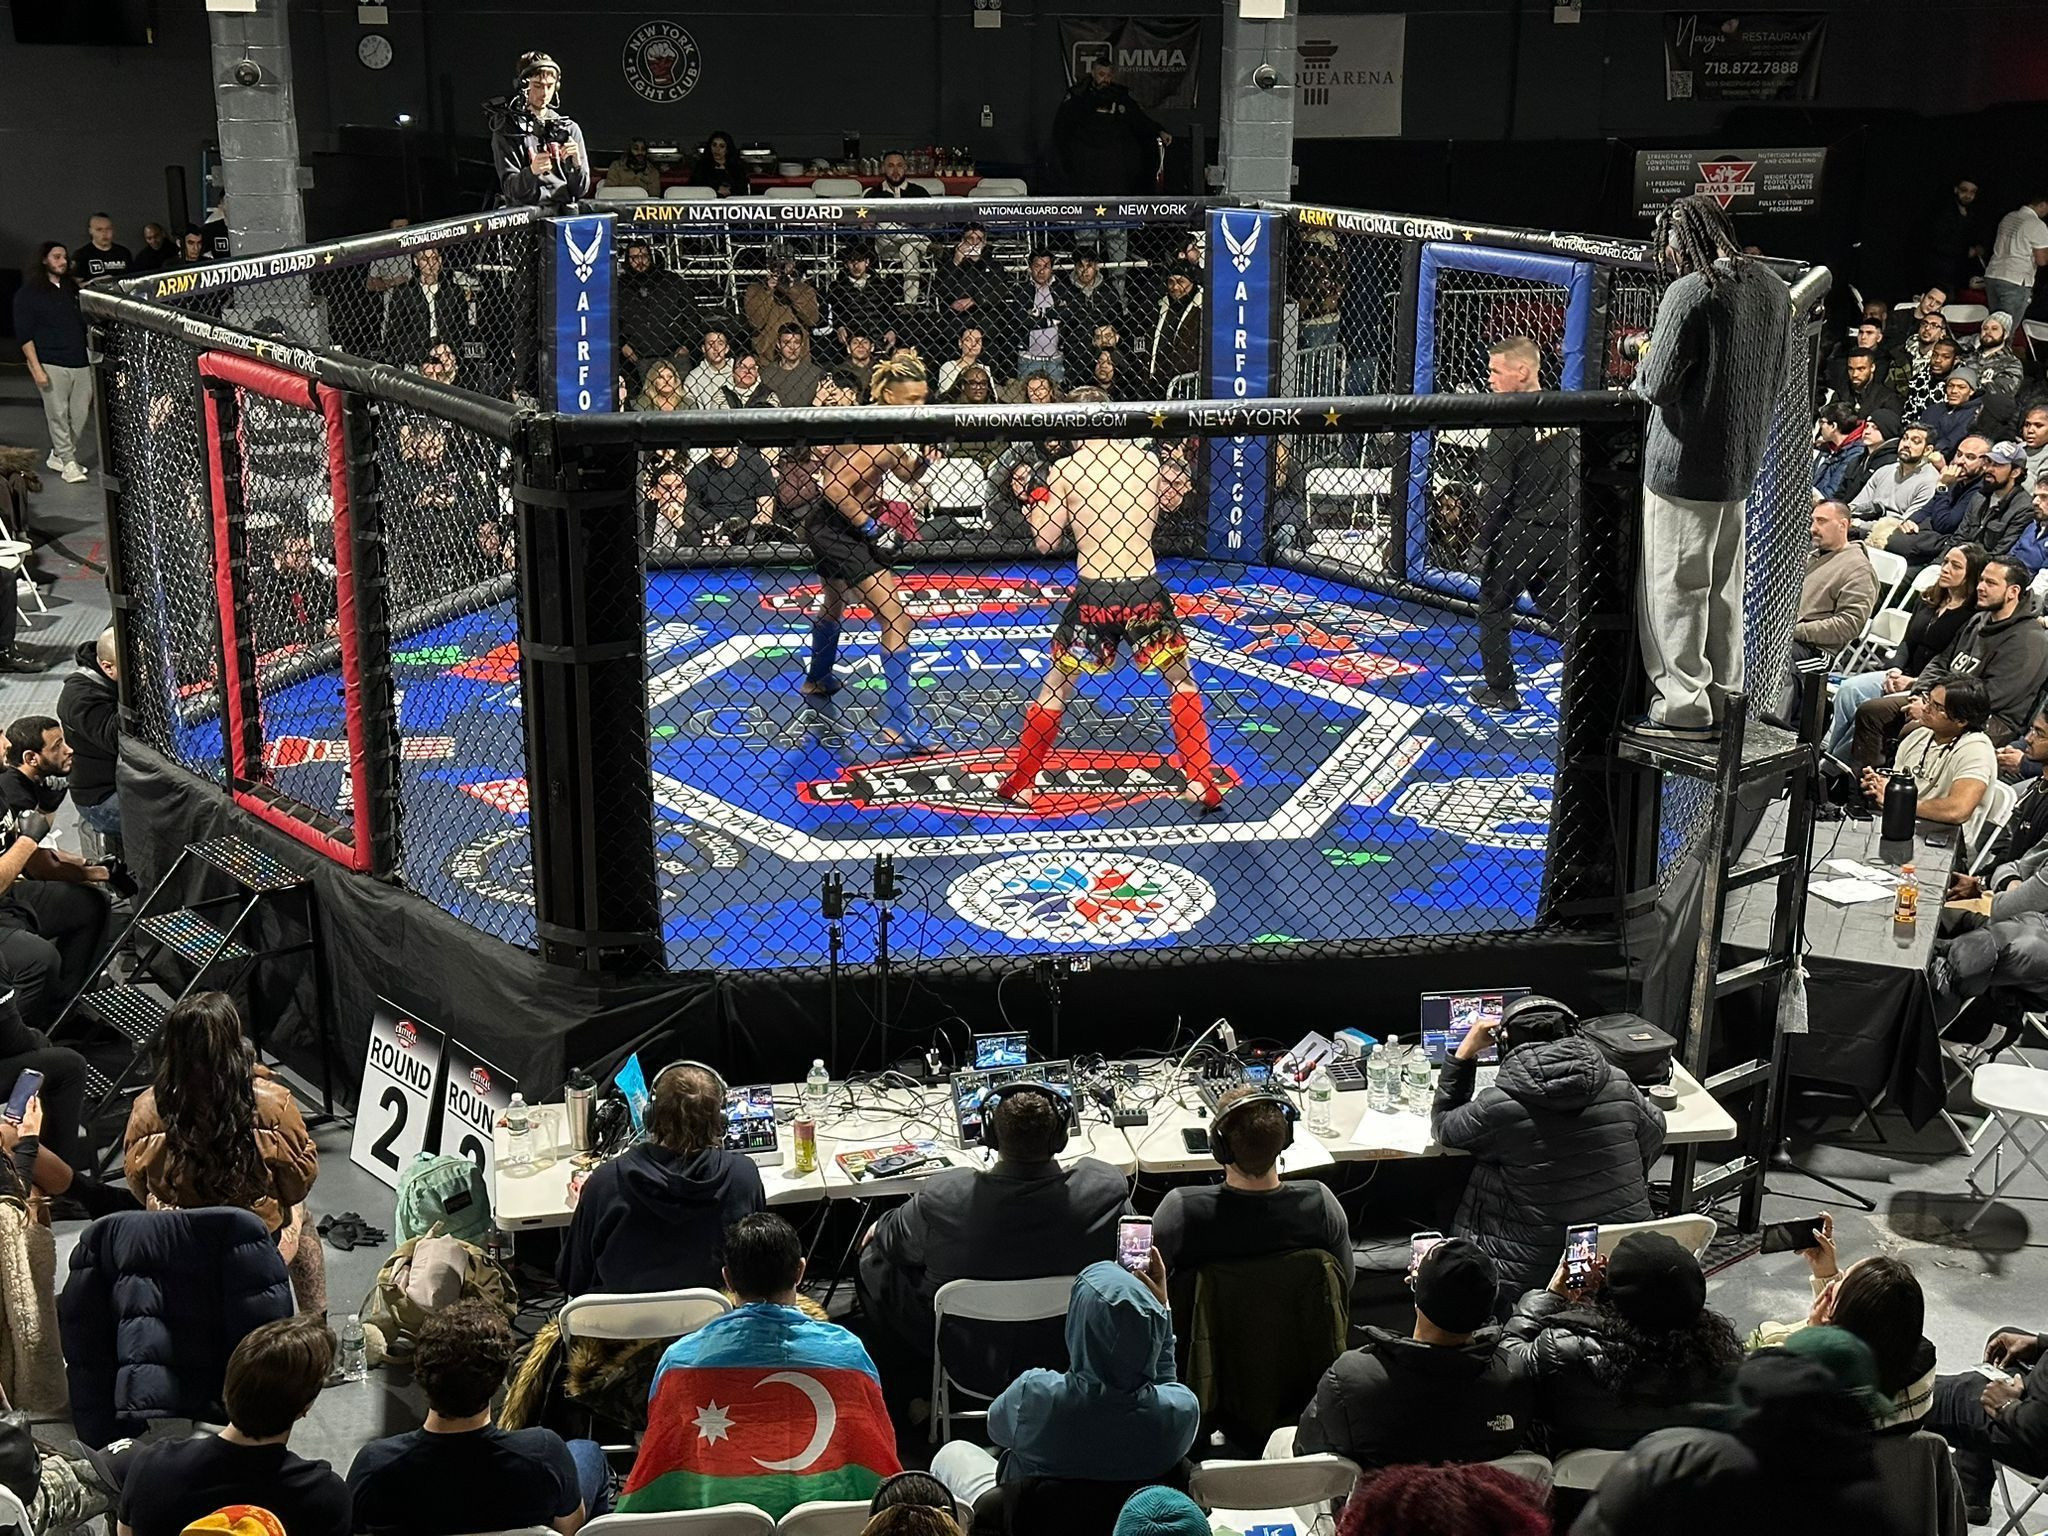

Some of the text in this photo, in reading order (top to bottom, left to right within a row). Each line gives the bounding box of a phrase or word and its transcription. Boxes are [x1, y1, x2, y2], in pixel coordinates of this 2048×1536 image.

[630, 24, 694, 55] NEW YORK
[1742, 32, 1812, 42] RESTAURANT
[1119, 49, 1187, 66] MMA
[1705, 62, 1799, 74] 718.872.7888
[626, 66, 697, 100] FIGHT CLUB
[633, 204, 843, 221] ARMY NATIONAL GUARD
[978, 203, 1187, 215] NATIONALGUARD.COM NEW YORK
[400, 212, 529, 248] NATIONALGUARD.COM NEW YORK
[1299, 209, 1454, 241] ARMY NATIONAL GUARD
[1552, 239, 1643, 262] NATIONALGUARD.COM
[156, 253, 316, 298] ARMY NATIONAL GUARD
[271, 346, 292, 366] NEW
[292, 349, 322, 375] YORK
[955, 408, 1301, 429] NATIONALGUARD.COM NEW YORK
[1228, 281, 1248, 549] AIRFOE.COM
[814, 767, 1222, 801] CRITICA
[868, 794, 953, 806] SPORTS
[1034, 784, 1182, 796] TERTAINMENT
[908, 827, 1204, 854] @csecombat
[370, 1035, 431, 1091] ROUND
[450, 1081, 495, 1134] ROUN
[371, 1086, 409, 1172] 2
